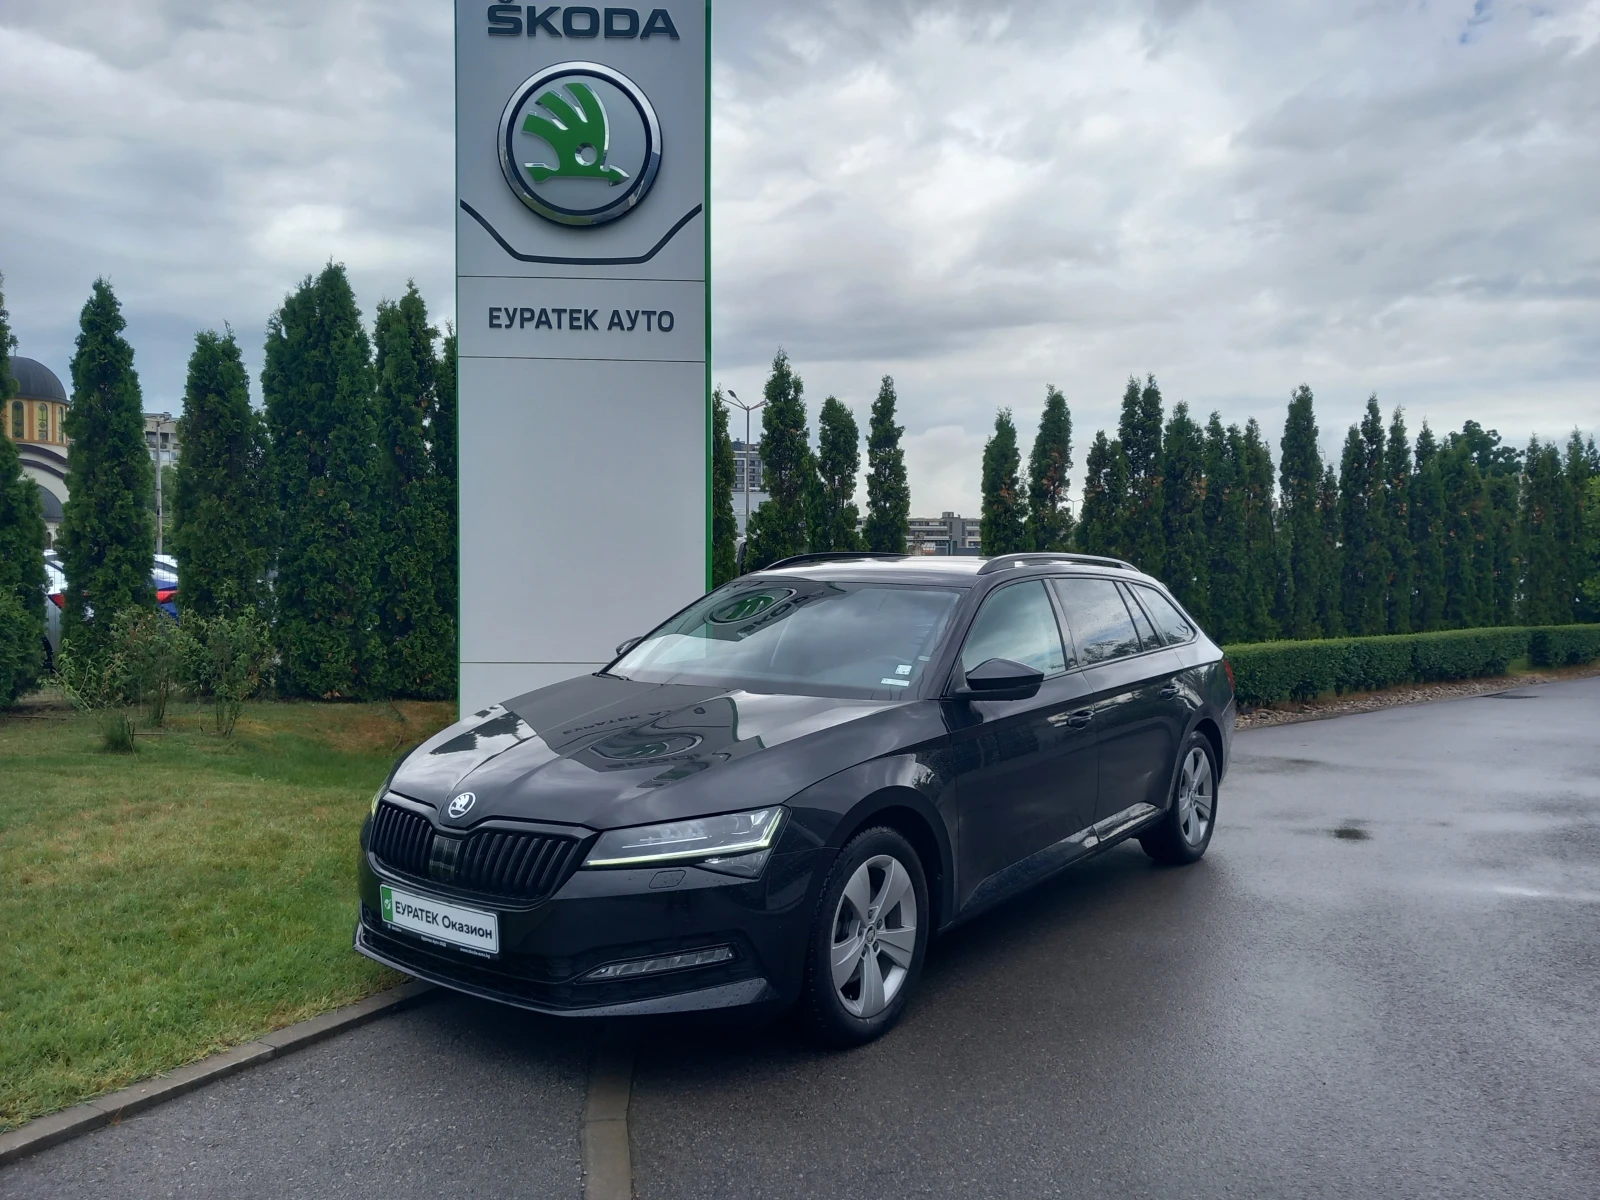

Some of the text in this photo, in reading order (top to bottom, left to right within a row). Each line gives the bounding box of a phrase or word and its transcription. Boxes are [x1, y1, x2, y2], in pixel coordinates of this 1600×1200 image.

[488, 0, 680, 40] ŠKODA
[488, 307, 675, 332] ЕУРАТЕК АУТО
[395, 901, 493, 940] ЕУРАТЕК Оказион
